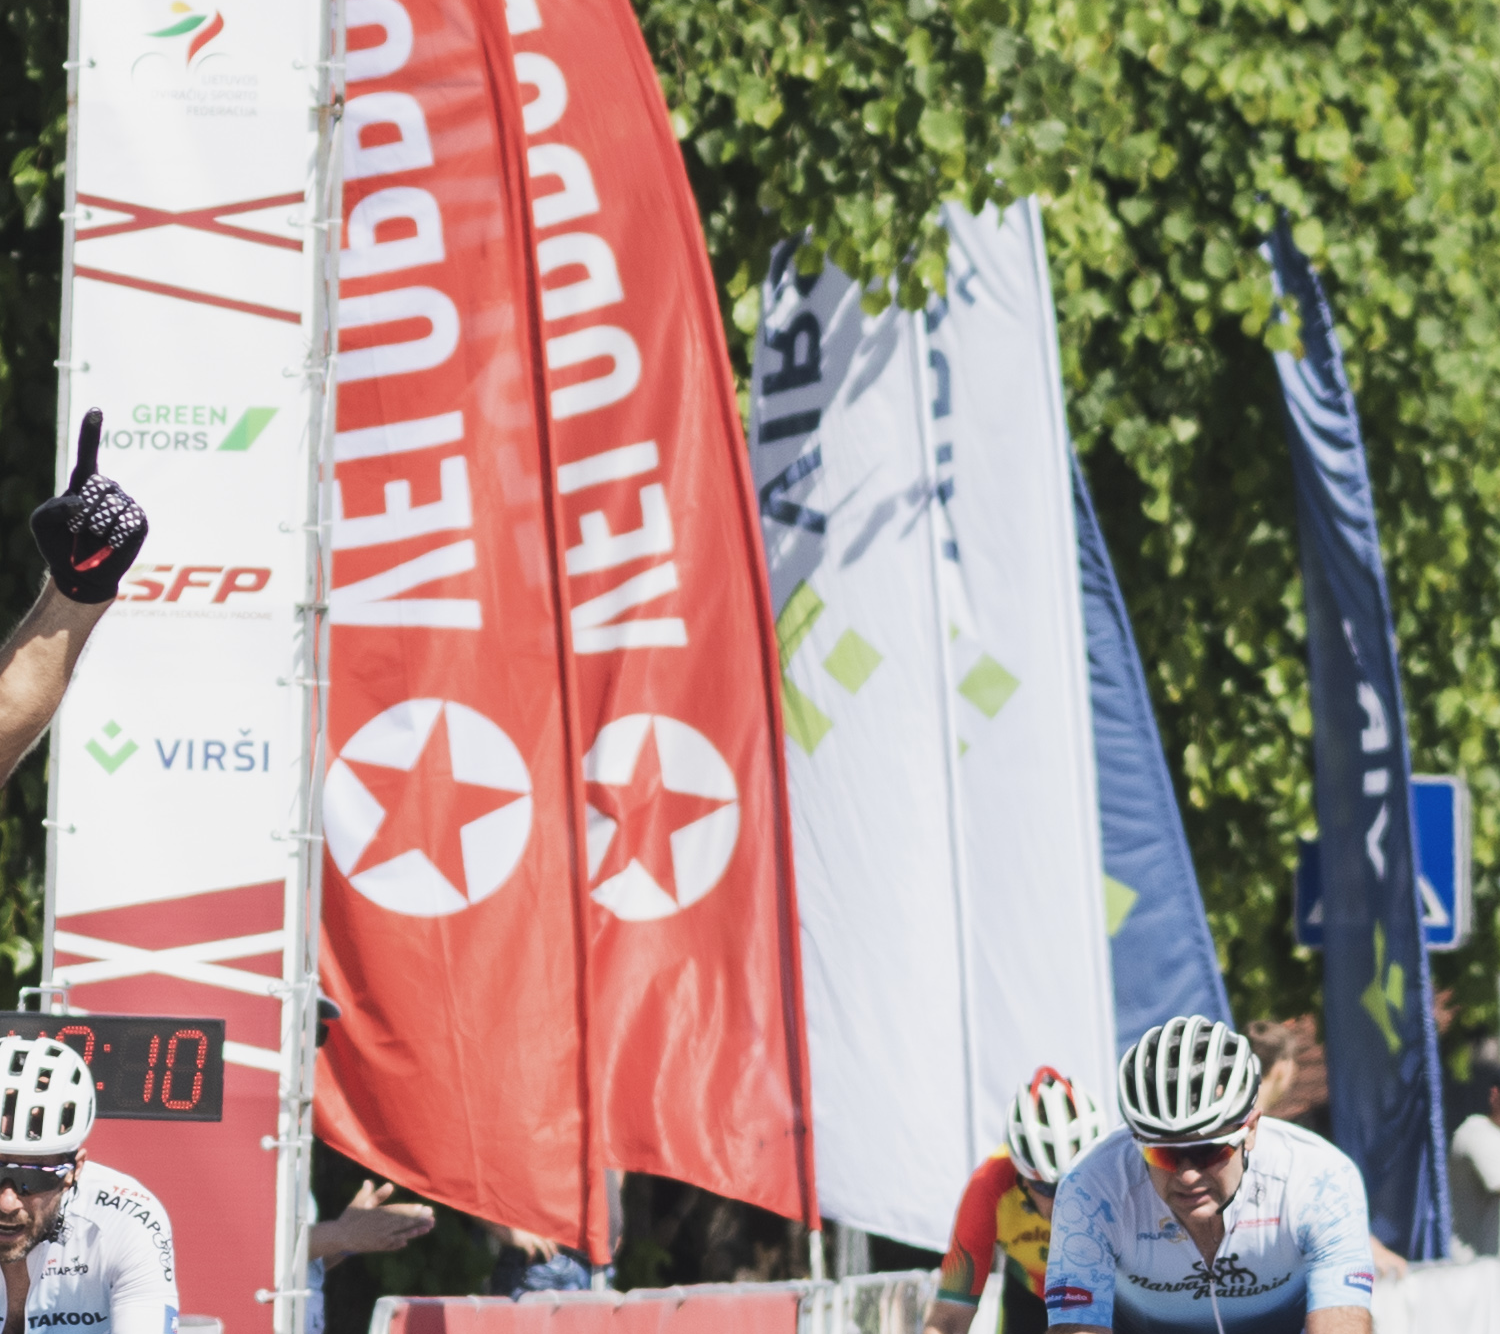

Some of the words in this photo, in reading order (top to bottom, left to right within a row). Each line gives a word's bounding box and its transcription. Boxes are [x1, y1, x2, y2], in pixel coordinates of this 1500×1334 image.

[131, 404, 228, 427] GREEN
[116, 563, 272, 604] SFP
[154, 727, 271, 773] VIRŠI
